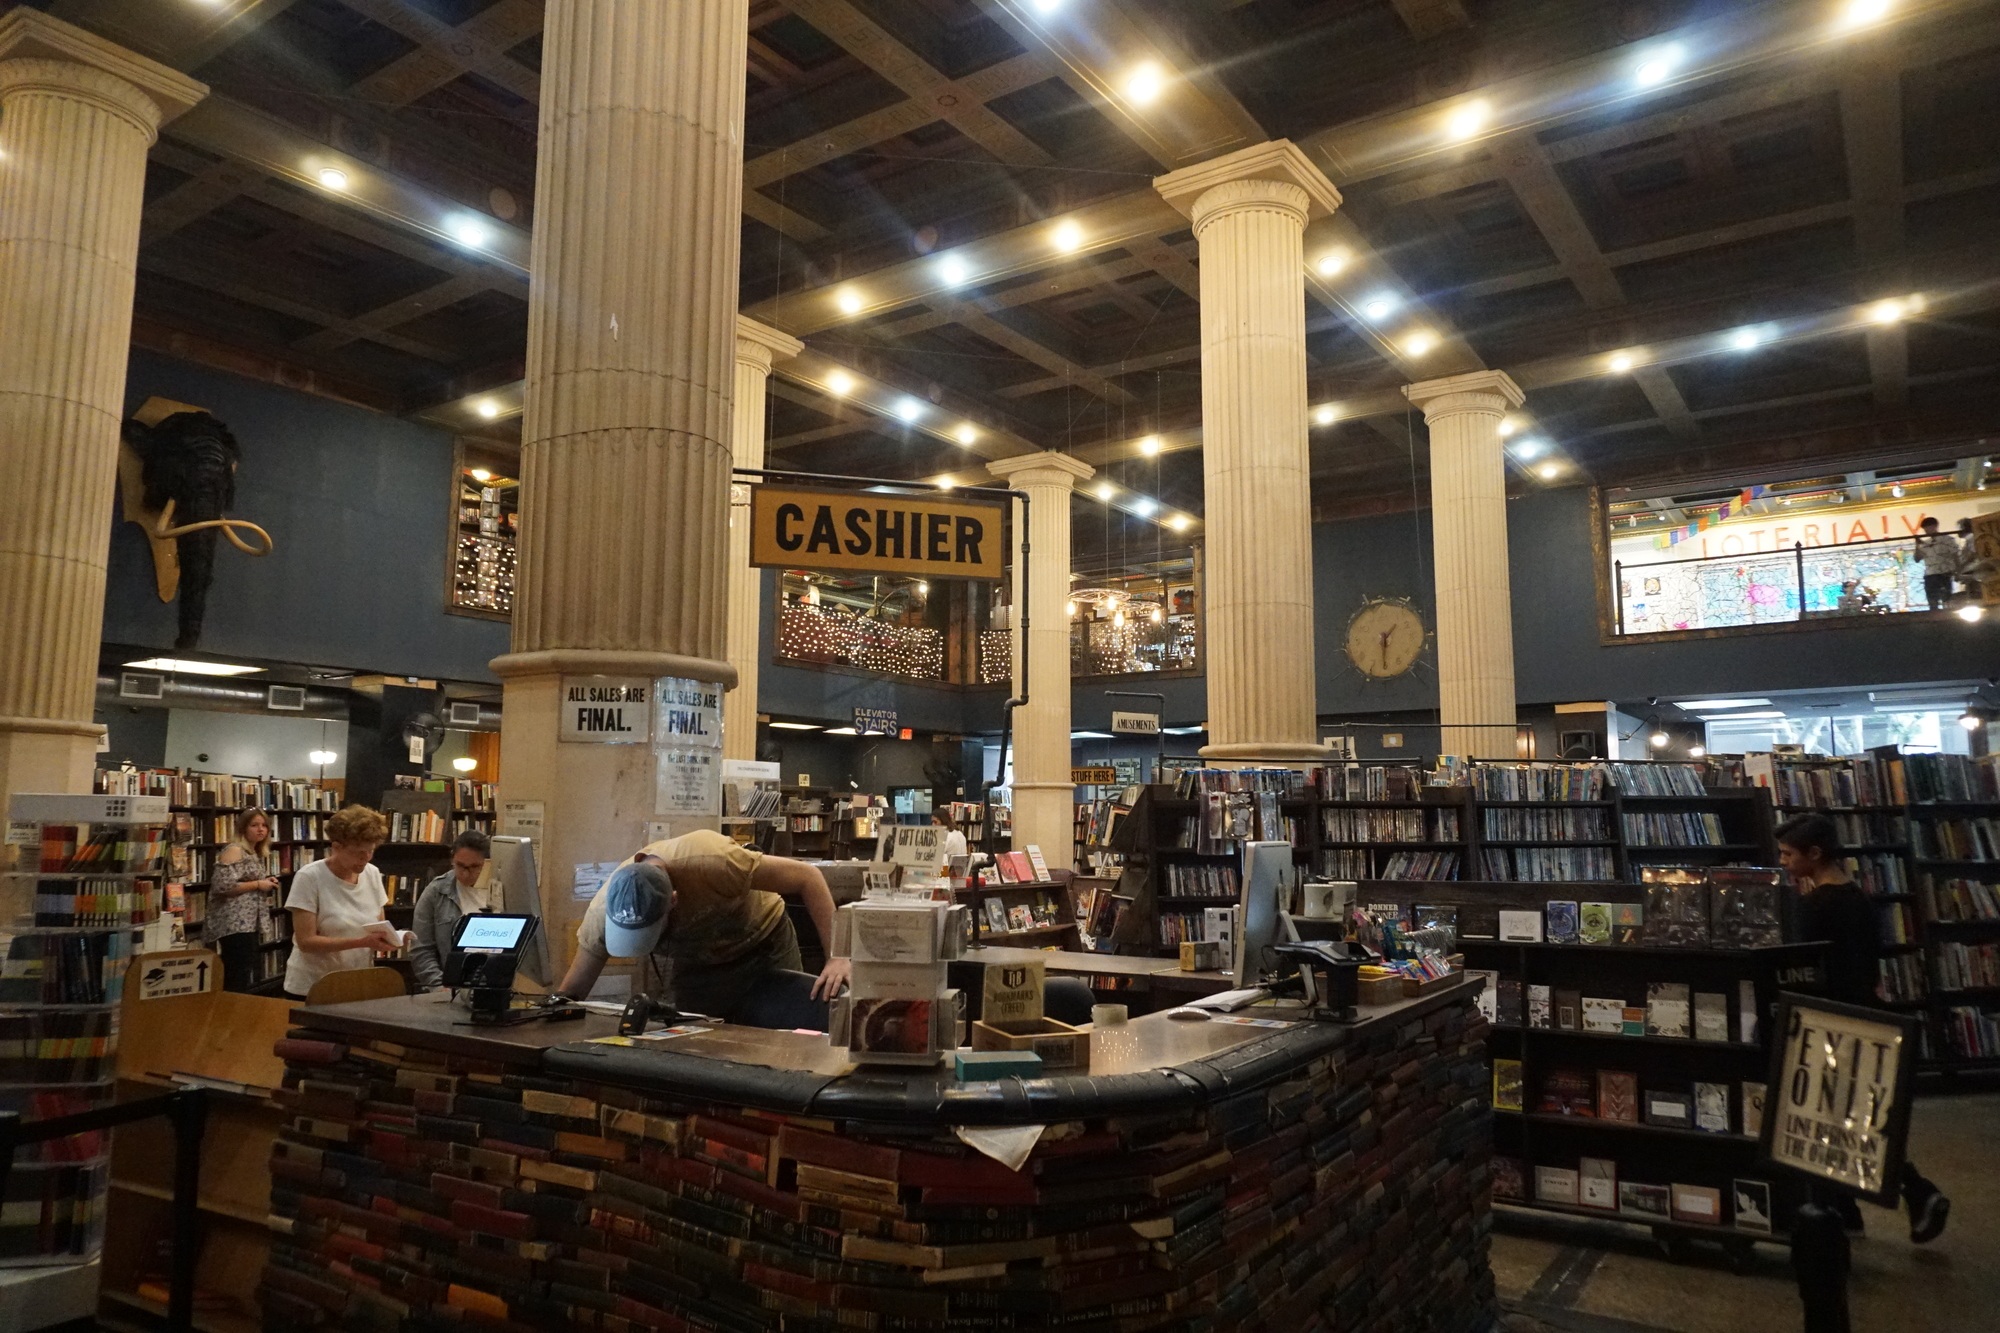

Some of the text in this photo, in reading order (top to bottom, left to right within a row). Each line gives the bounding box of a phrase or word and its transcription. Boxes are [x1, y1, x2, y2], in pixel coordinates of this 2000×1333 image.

[775, 503, 983, 564] CASHIER
[568, 687, 645, 703] ALL SALES ARE
[662, 688, 717, 709] ALL SALES ARE
[577, 708, 632, 732] FINAL.
[855, 707, 897, 719] ELEVATOR
[669, 710, 708, 736] FINAL.
[855, 717, 897, 736] STAIRS
[1116, 719, 1156, 731] AMUSEMENTS
[1071, 771, 1092, 782] STUFF
[1093, 771, 1110, 782] HERE
[899, 828, 938, 847] GIFT CARDS
[924, 849, 936, 861] sale!
[476, 928, 508, 938] Genius
[1776, 966, 1816, 984] LINE
[993, 990, 1034, 1002] BOOKMARKS
[1799, 1028, 1892, 1085] EXIT
[1790, 1068, 1888, 1126] ONLY
[1787, 1114, 1811, 1139] LINE
[1784, 1134, 1808, 1159] THE
